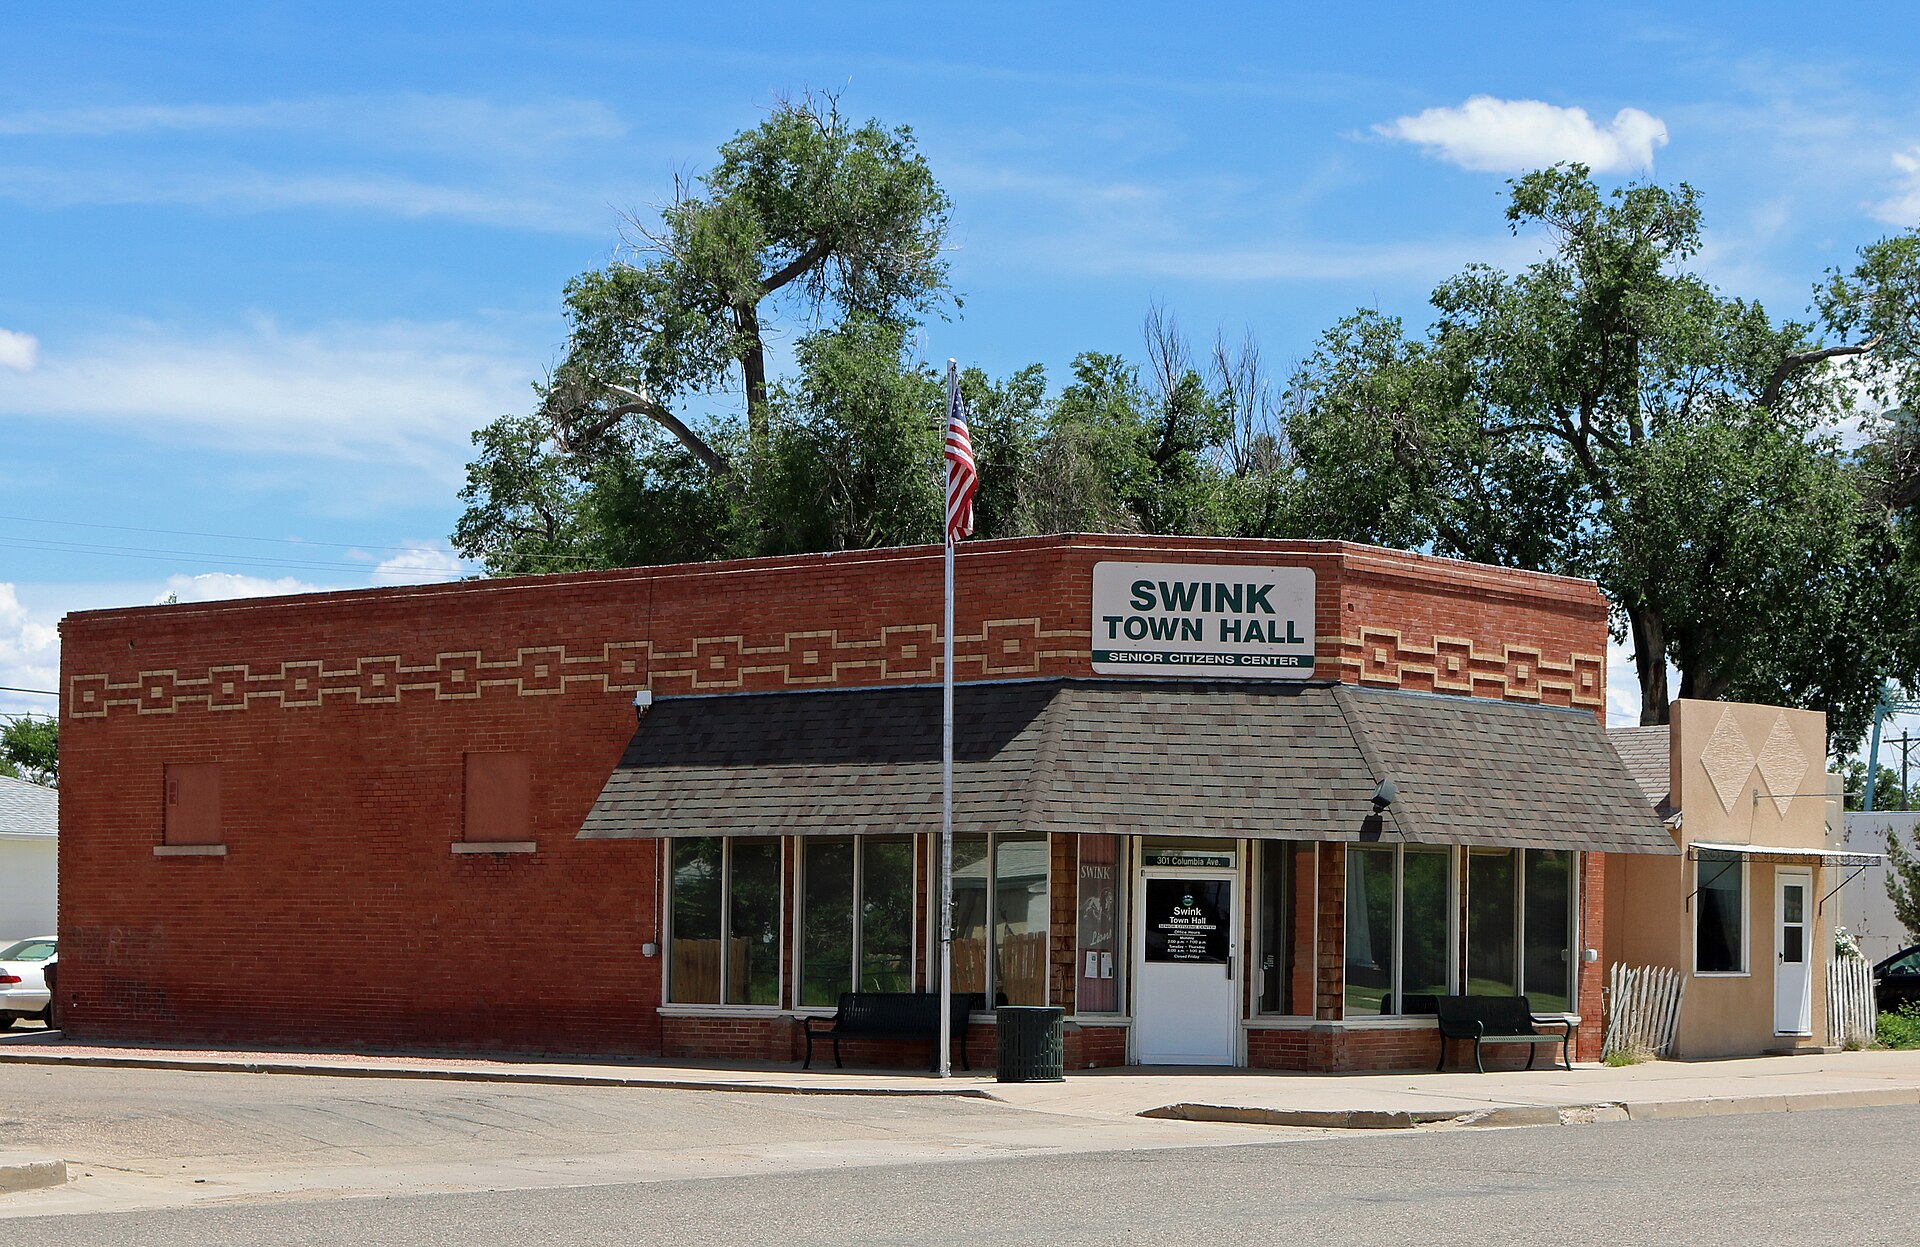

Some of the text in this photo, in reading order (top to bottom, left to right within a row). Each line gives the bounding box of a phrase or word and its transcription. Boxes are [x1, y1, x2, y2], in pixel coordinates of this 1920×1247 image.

[1130, 580, 1276, 614] SWINK
[1102, 615, 1305, 644] TOWN HALL
[1108, 652, 1299, 666] SENIOR CITIZENS CENTER
[1157, 857, 1221, 866] 301 Columbia Ave.
[1080, 865, 1110, 880] SWINK
[1173, 907, 1202, 916] Swink
[1169, 916, 1189, 924] Town
